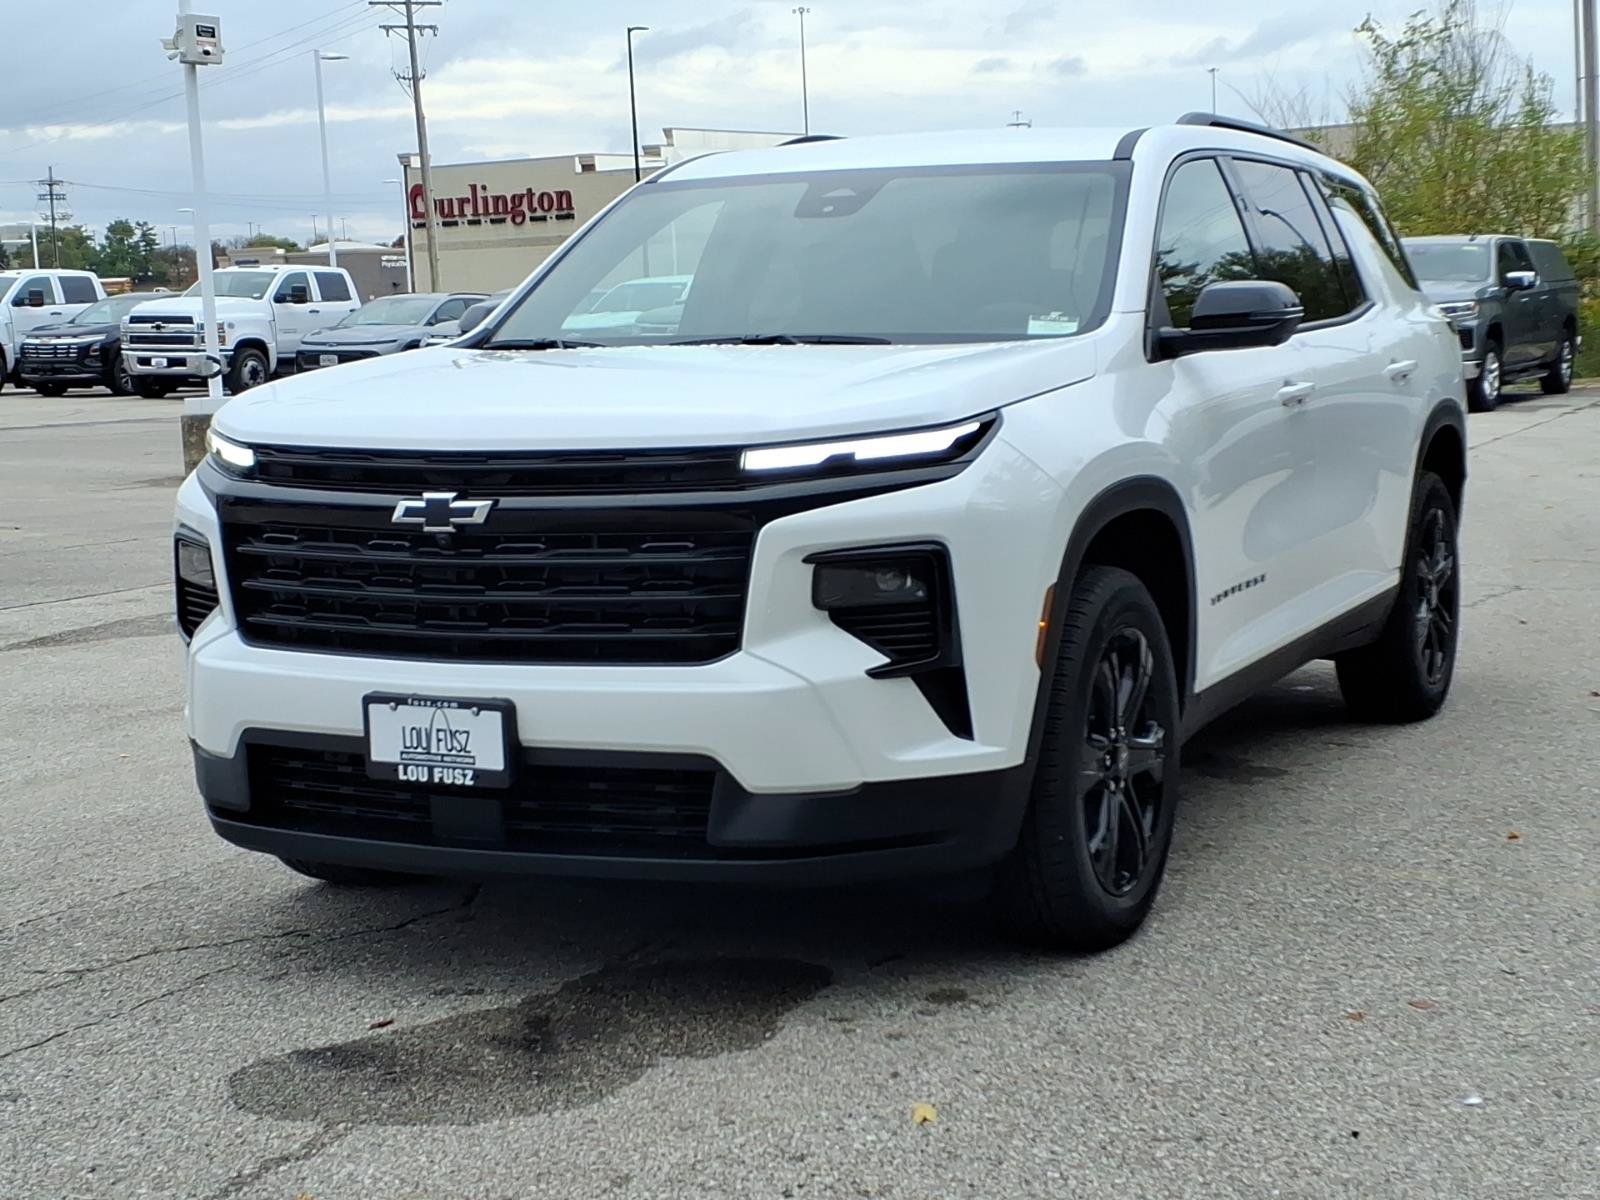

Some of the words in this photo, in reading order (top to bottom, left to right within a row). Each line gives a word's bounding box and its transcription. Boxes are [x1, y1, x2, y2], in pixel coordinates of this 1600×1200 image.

[402, 726, 430, 751] LOU
[436, 728, 471, 753] FUSZ
[397, 765, 428, 782] LOU
[433, 767, 475, 785] FUSZ
